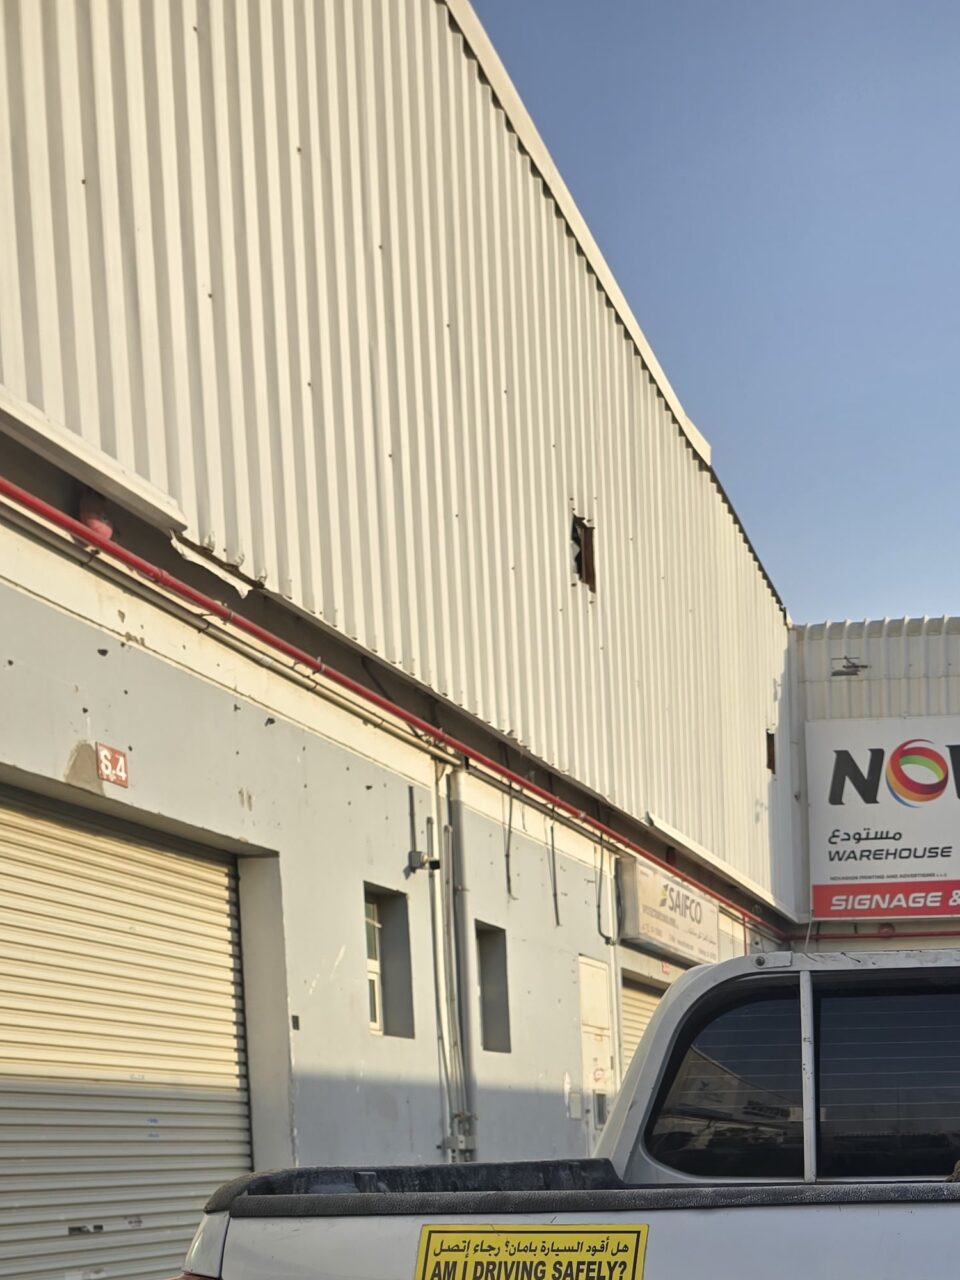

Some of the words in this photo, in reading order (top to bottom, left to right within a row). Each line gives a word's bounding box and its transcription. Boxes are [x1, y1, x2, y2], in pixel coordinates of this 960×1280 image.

[828, 828, 903, 845] مستودع
[828, 846, 953, 862] WAREHOUSE
[668, 886, 702, 924] SAIFCO
[830, 891, 943, 910] SIGNAGE
[473, 1240, 501, 1257] رجاء
[540, 1241, 583, 1257] السيارة
[586, 1236, 610, 1256] أقود
[611, 1241, 629, 1256] هل
[430, 1260, 457, 1280] AM
[460, 1260, 468, 1280] I
